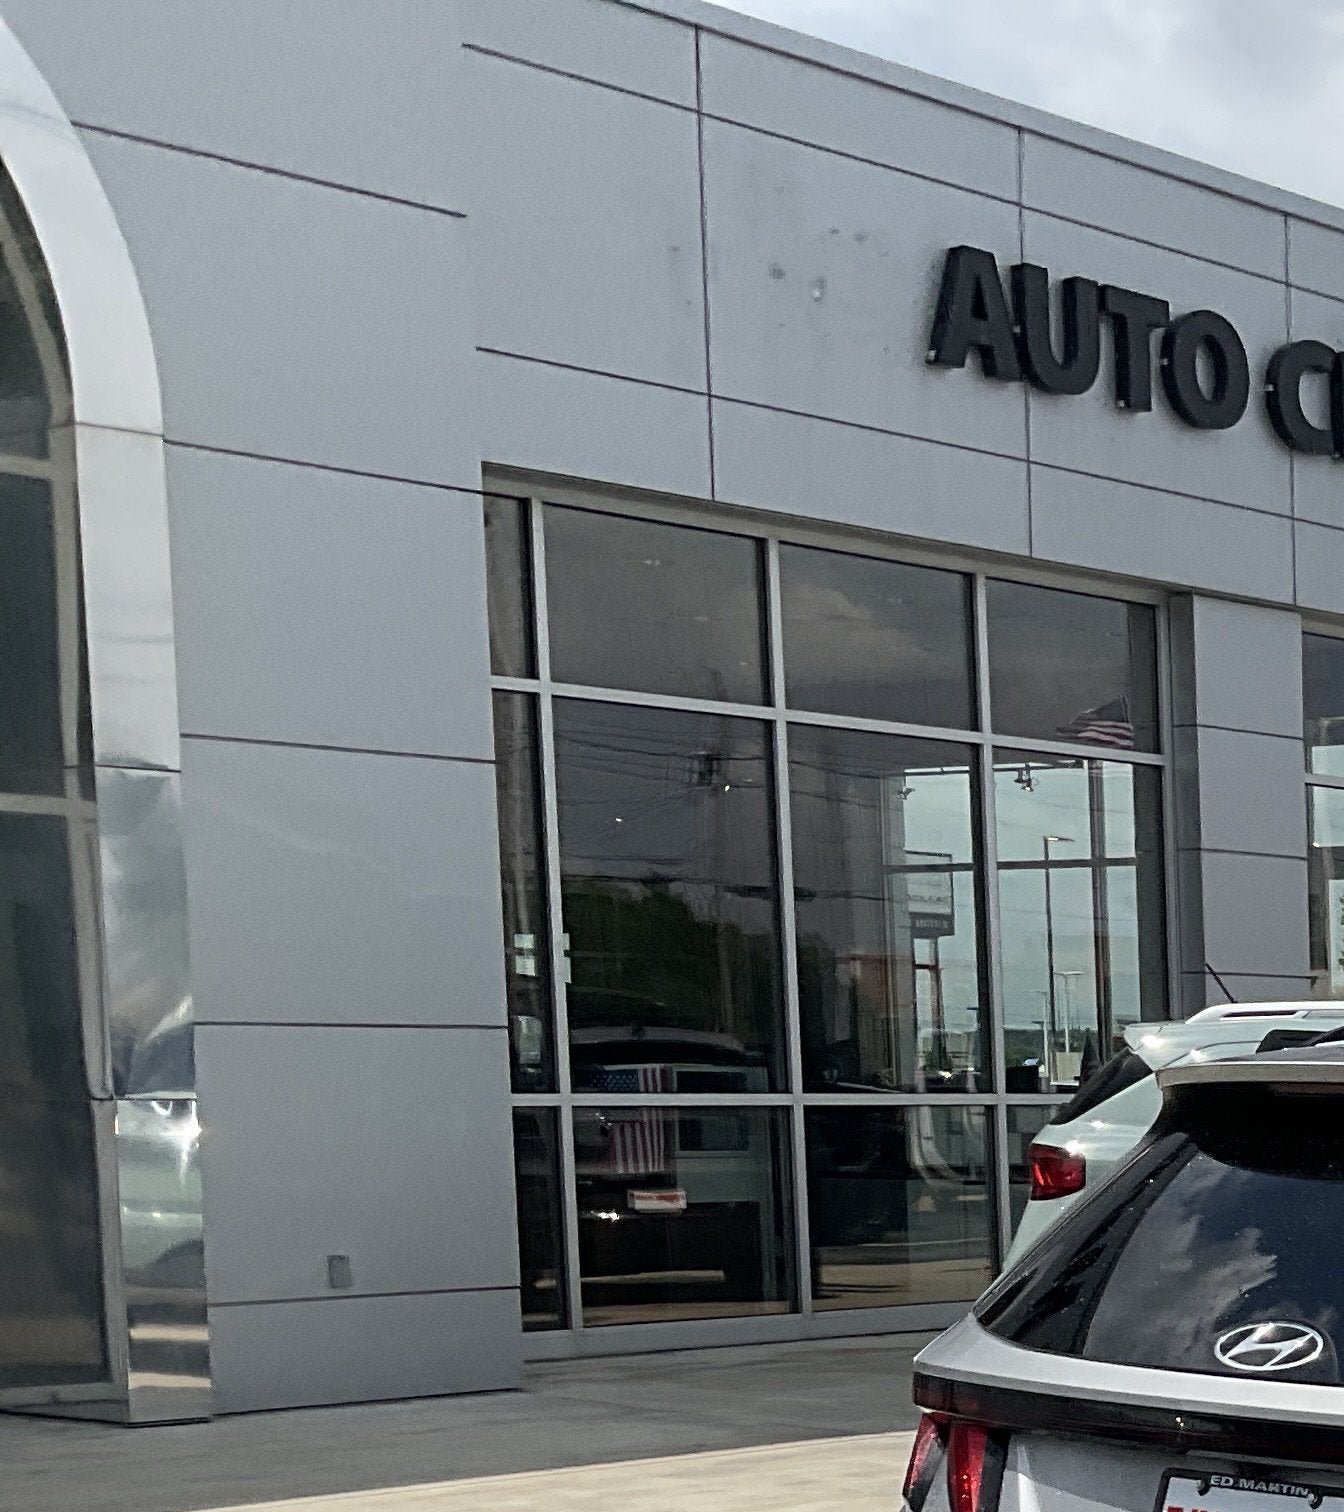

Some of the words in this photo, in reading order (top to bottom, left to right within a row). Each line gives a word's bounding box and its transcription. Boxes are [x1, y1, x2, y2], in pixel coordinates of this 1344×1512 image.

[926, 244, 1250, 430] AUTO
[1210, 1474, 1234, 1487] ED
[1239, 1478, 1309, 1497] MARTIN
